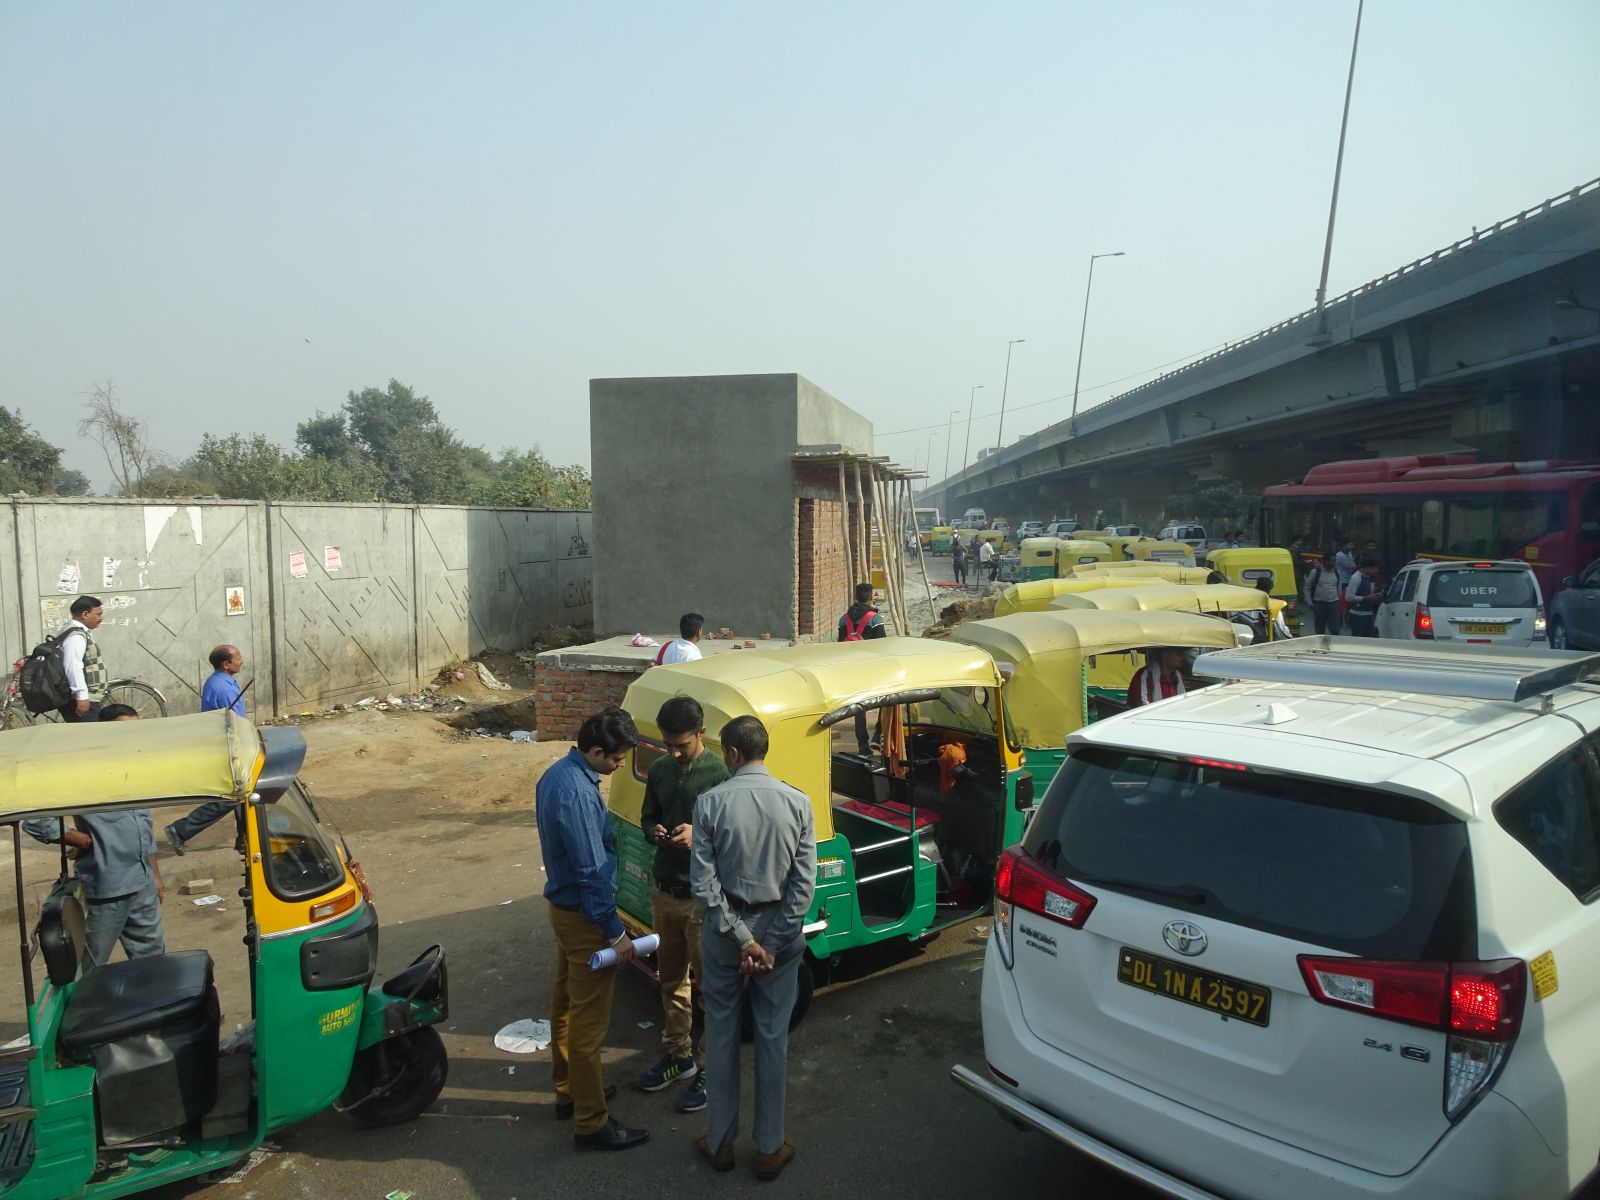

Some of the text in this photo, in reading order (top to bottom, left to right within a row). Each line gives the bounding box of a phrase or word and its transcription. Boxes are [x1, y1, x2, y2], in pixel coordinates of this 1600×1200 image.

[1460, 587, 1498, 595] UBER
[1133, 960, 1157, 988] DL
[1206, 981, 1265, 1019] 2597
